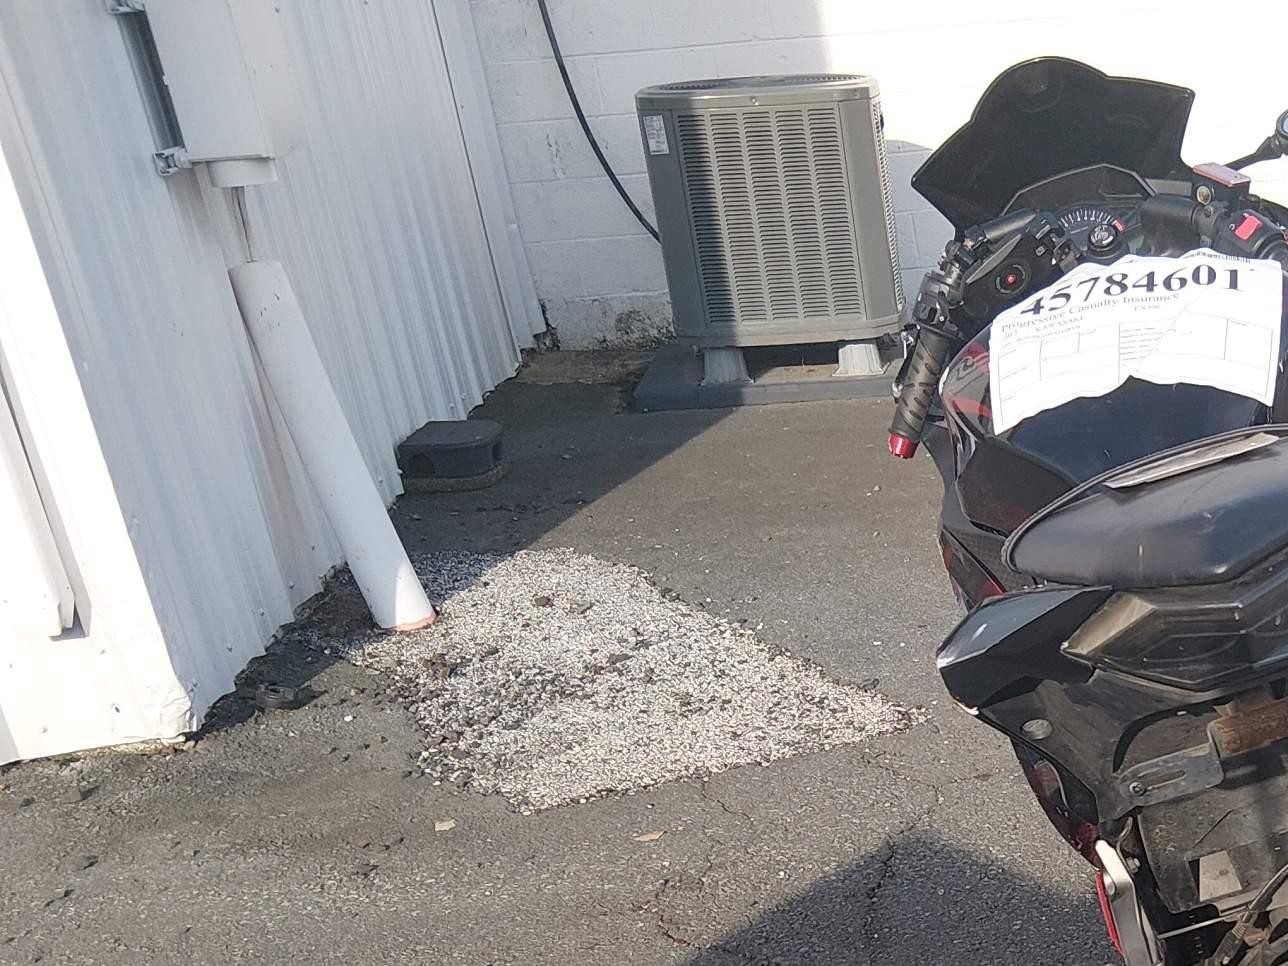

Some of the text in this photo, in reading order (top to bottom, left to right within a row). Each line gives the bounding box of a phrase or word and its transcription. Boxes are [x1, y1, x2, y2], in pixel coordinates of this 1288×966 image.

[1001, 311, 1066, 333] Progressive
[1069, 297, 1118, 314] Casualty
[1123, 292, 1180, 304] Insurance
[1020, 263, 1244, 316] 45784601
